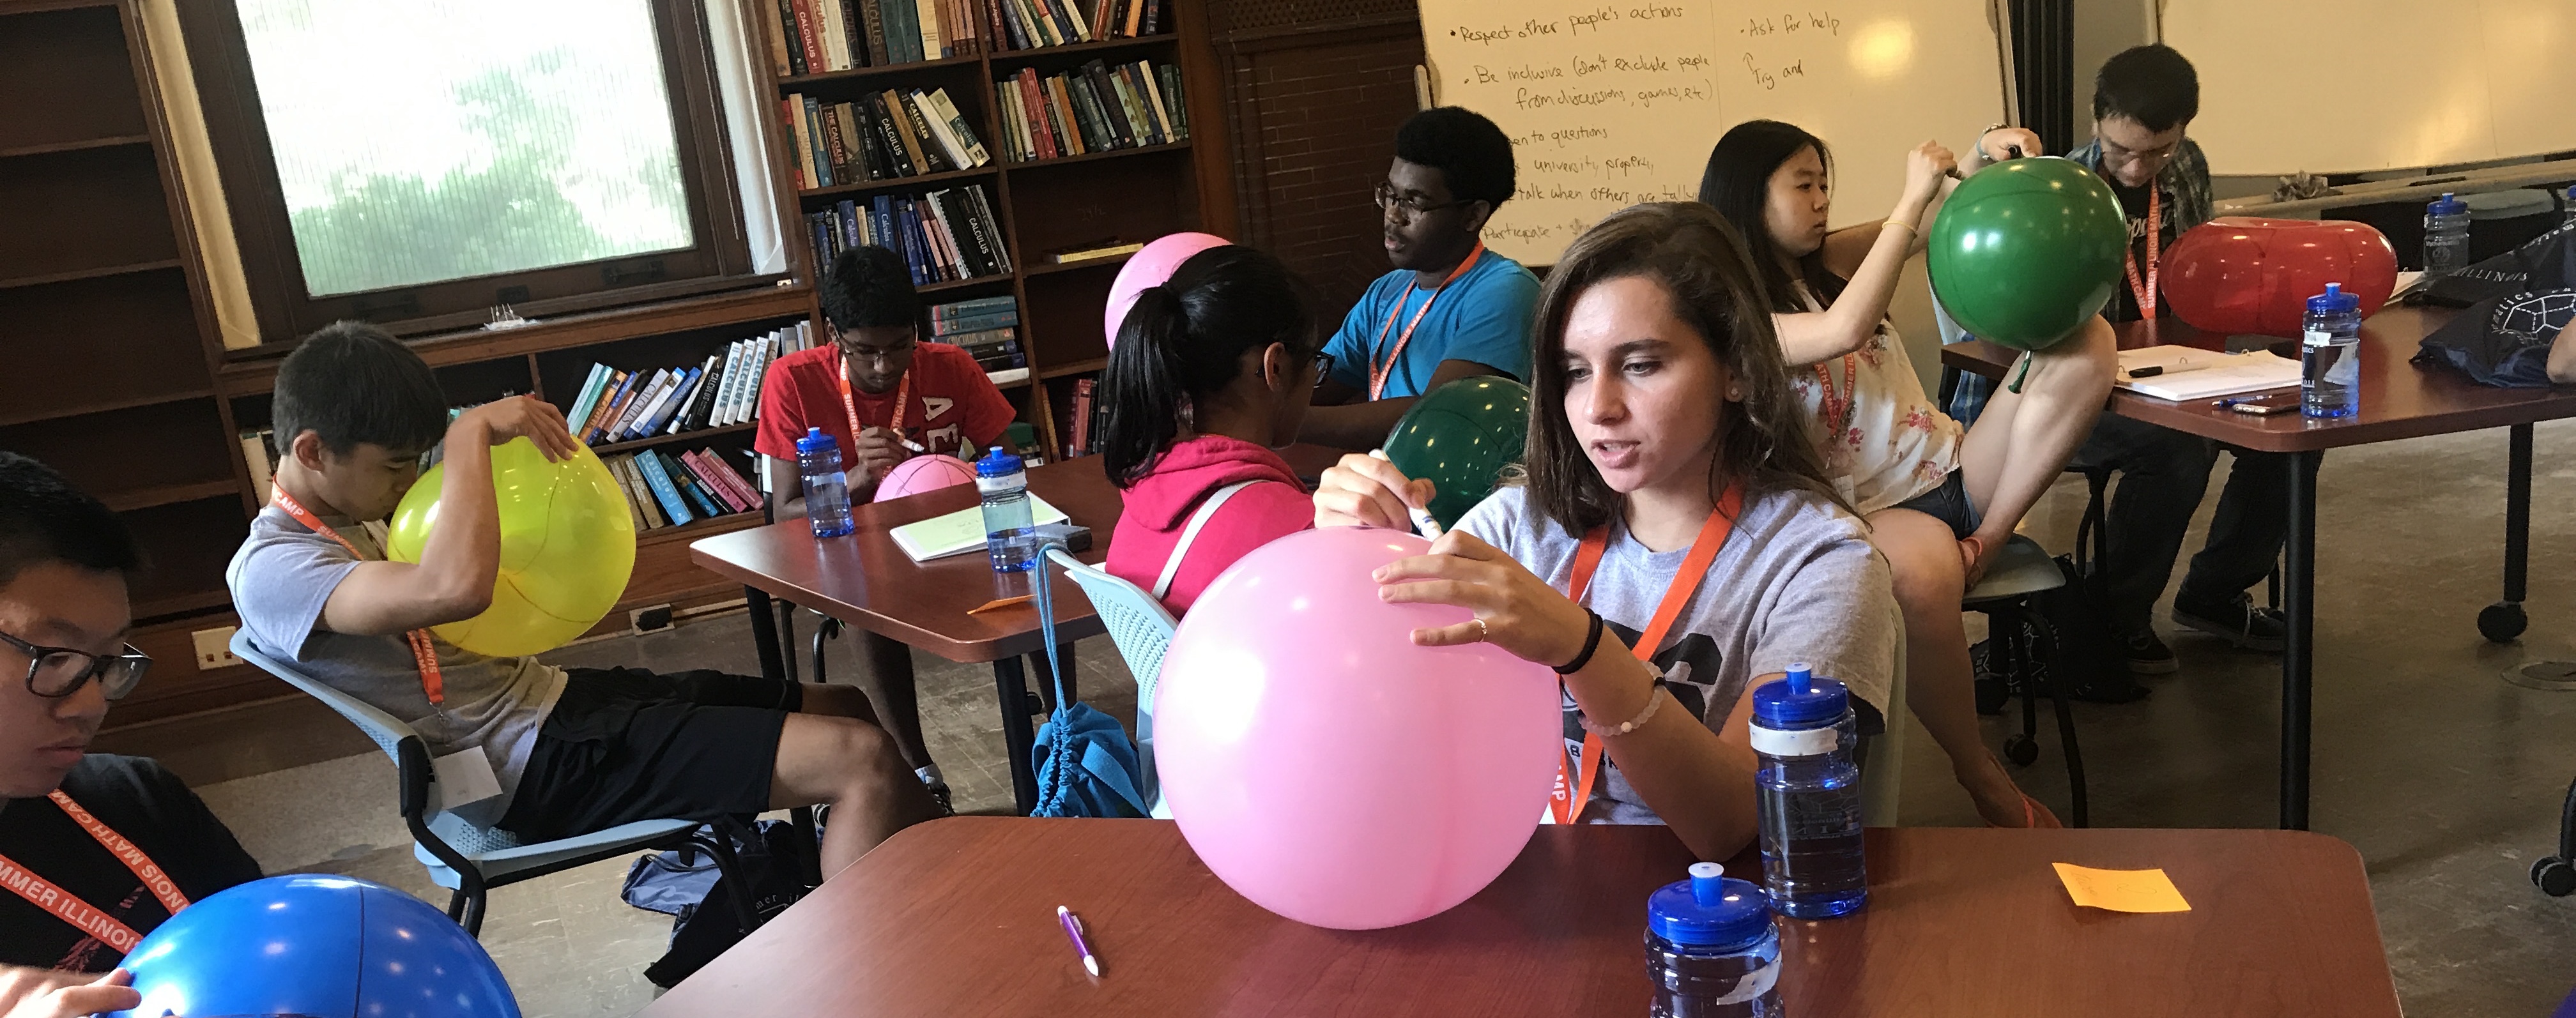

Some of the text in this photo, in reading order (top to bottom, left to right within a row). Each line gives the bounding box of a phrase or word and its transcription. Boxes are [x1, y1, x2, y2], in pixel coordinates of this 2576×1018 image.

[799, 11, 816, 58] CALCULUS
[1460, 3, 1683, 46] Respect other people's actions
[1750, 11, 1839, 37] Ask for help
[1473, 54, 1710, 84] Be inclusive (don't exclude people
[1752, 59, 1804, 90] Try and
[1515, 87, 1555, 110] from
[882, 118, 903, 156] CALCULUS
[909, 103, 929, 139] CALCULUS
[954, 118, 975, 146] Calculus
[1531, 130, 1545, 143] to
[1551, 126, 1608, 148] questions
[831, 126, 845, 165] CALCULUS
[1535, 155, 1598, 178] university
[1518, 183, 1545, 200] talk
[1551, 183, 1584, 201] when
[1590, 187, 1629, 204] others
[1637, 193, 1656, 203] are
[847, 219, 857, 247] Calculus
[881, 214, 891, 241] Calculus
[969, 217, 989, 254] CALCULUS
[2147, 271, 2157, 309] SUMMER
[703, 372, 719, 401] CALCULUS
[719, 356, 739, 408] CALCULUS
[733, 354, 752, 406] CALCULUS
[747, 351, 765, 403] CALCULUS
[622, 383, 657, 425] CALCULUS
[844, 393, 858, 434] SUMMER
[645, 454, 673, 498] Calculus
[694, 460, 730, 497] CALCULUS
[274, 491, 305, 516] CAMP
[91, 824, 145, 865] MATH
